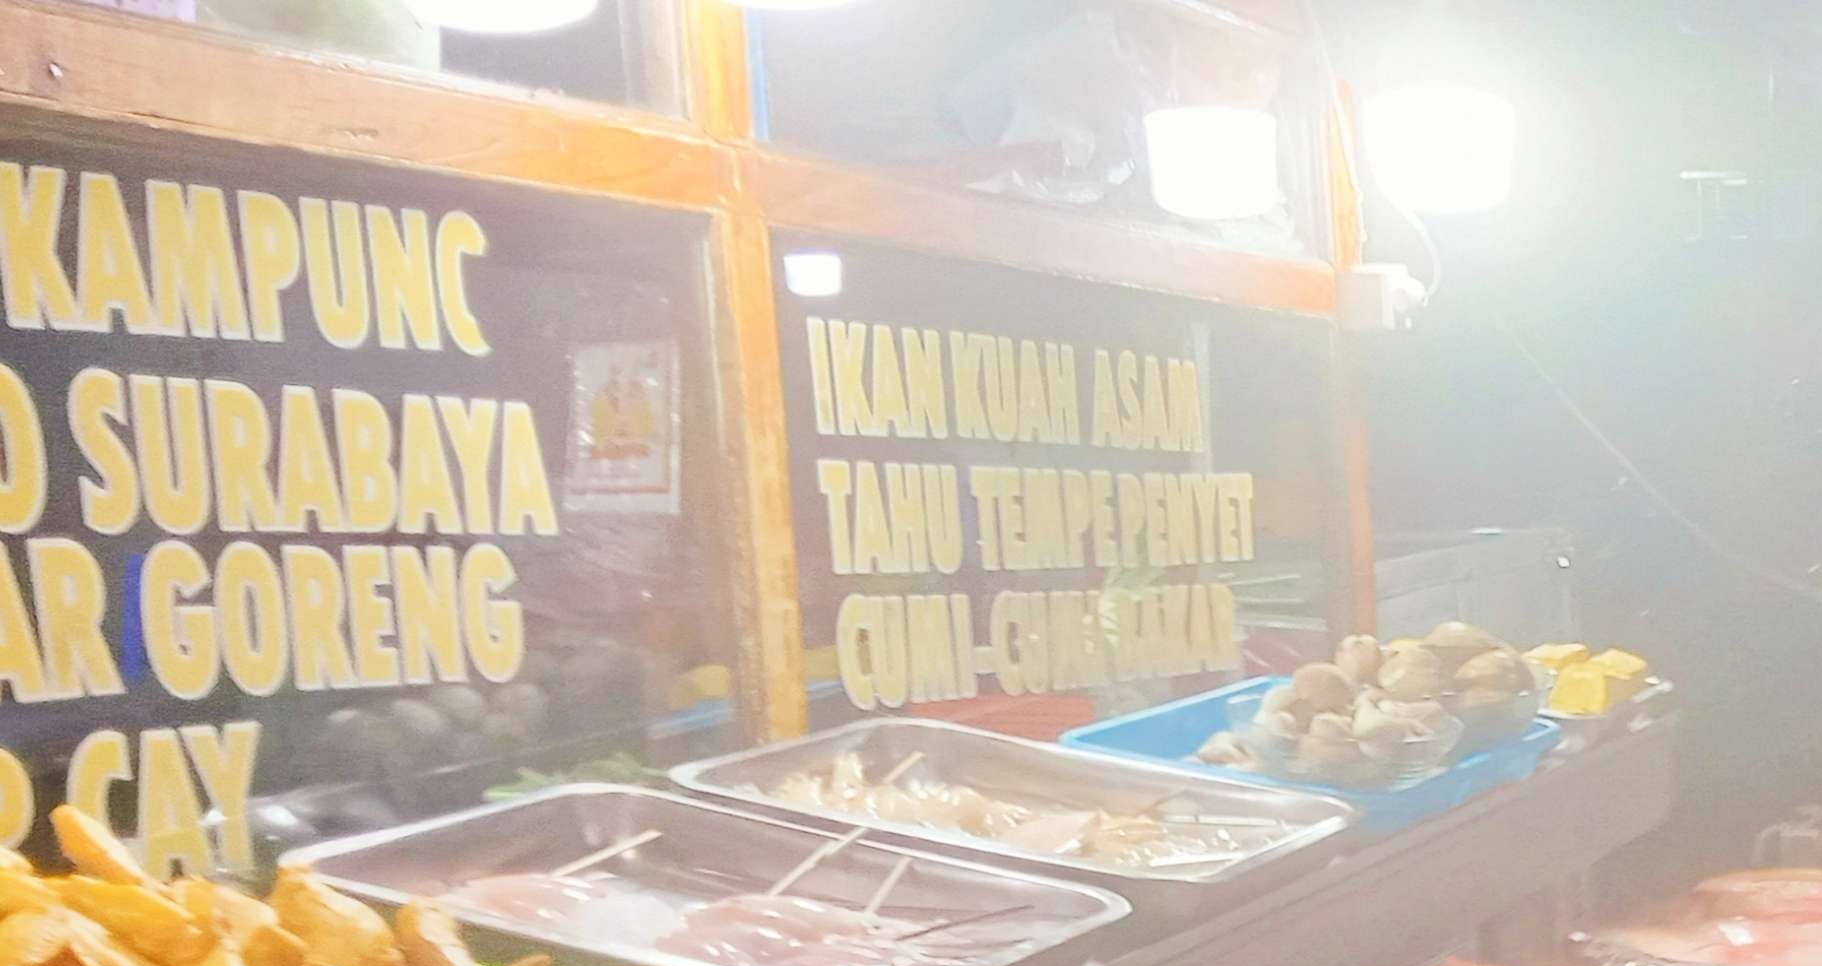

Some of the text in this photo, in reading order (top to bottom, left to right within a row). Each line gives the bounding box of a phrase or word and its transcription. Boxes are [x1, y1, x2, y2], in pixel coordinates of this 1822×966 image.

[67, 367, 559, 536] SURABAYA
[806, 316, 1203, 454] IKAN KUAH ASAM
[817, 459, 1254, 575] TAHU TEMPE PENYET
[140, 540, 524, 700] GORENG
[66, 720, 263, 886] CAY
